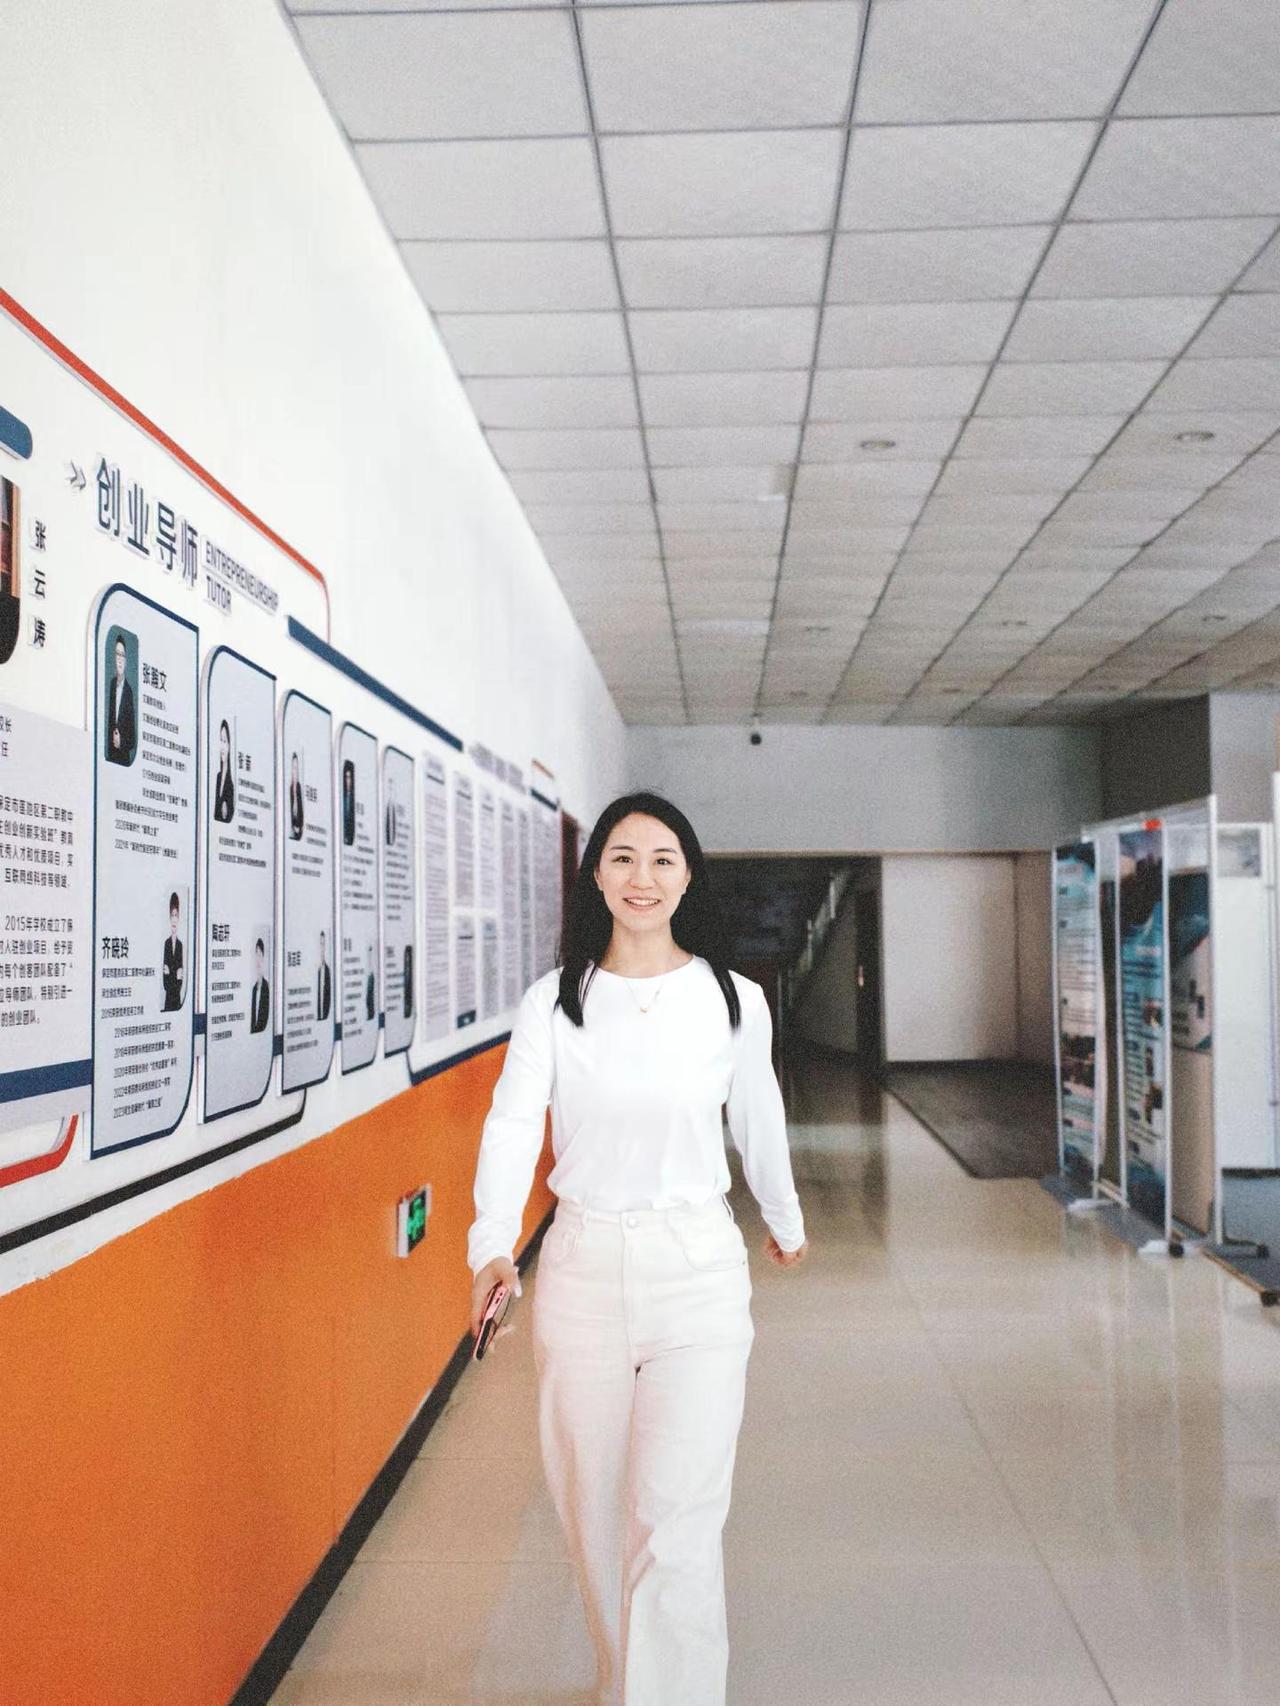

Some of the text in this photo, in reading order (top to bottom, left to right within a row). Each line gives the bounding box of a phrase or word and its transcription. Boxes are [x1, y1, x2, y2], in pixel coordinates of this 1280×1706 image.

[97, 457, 198, 587] 创业导师
[206, 540, 279, 612] ENTREPRENEURSHIP
[206, 575, 232, 613] TUTOR
[102, 936, 129, 959] 齐晓玲
[1, 1010, 41, 1027] 的创业团队。
